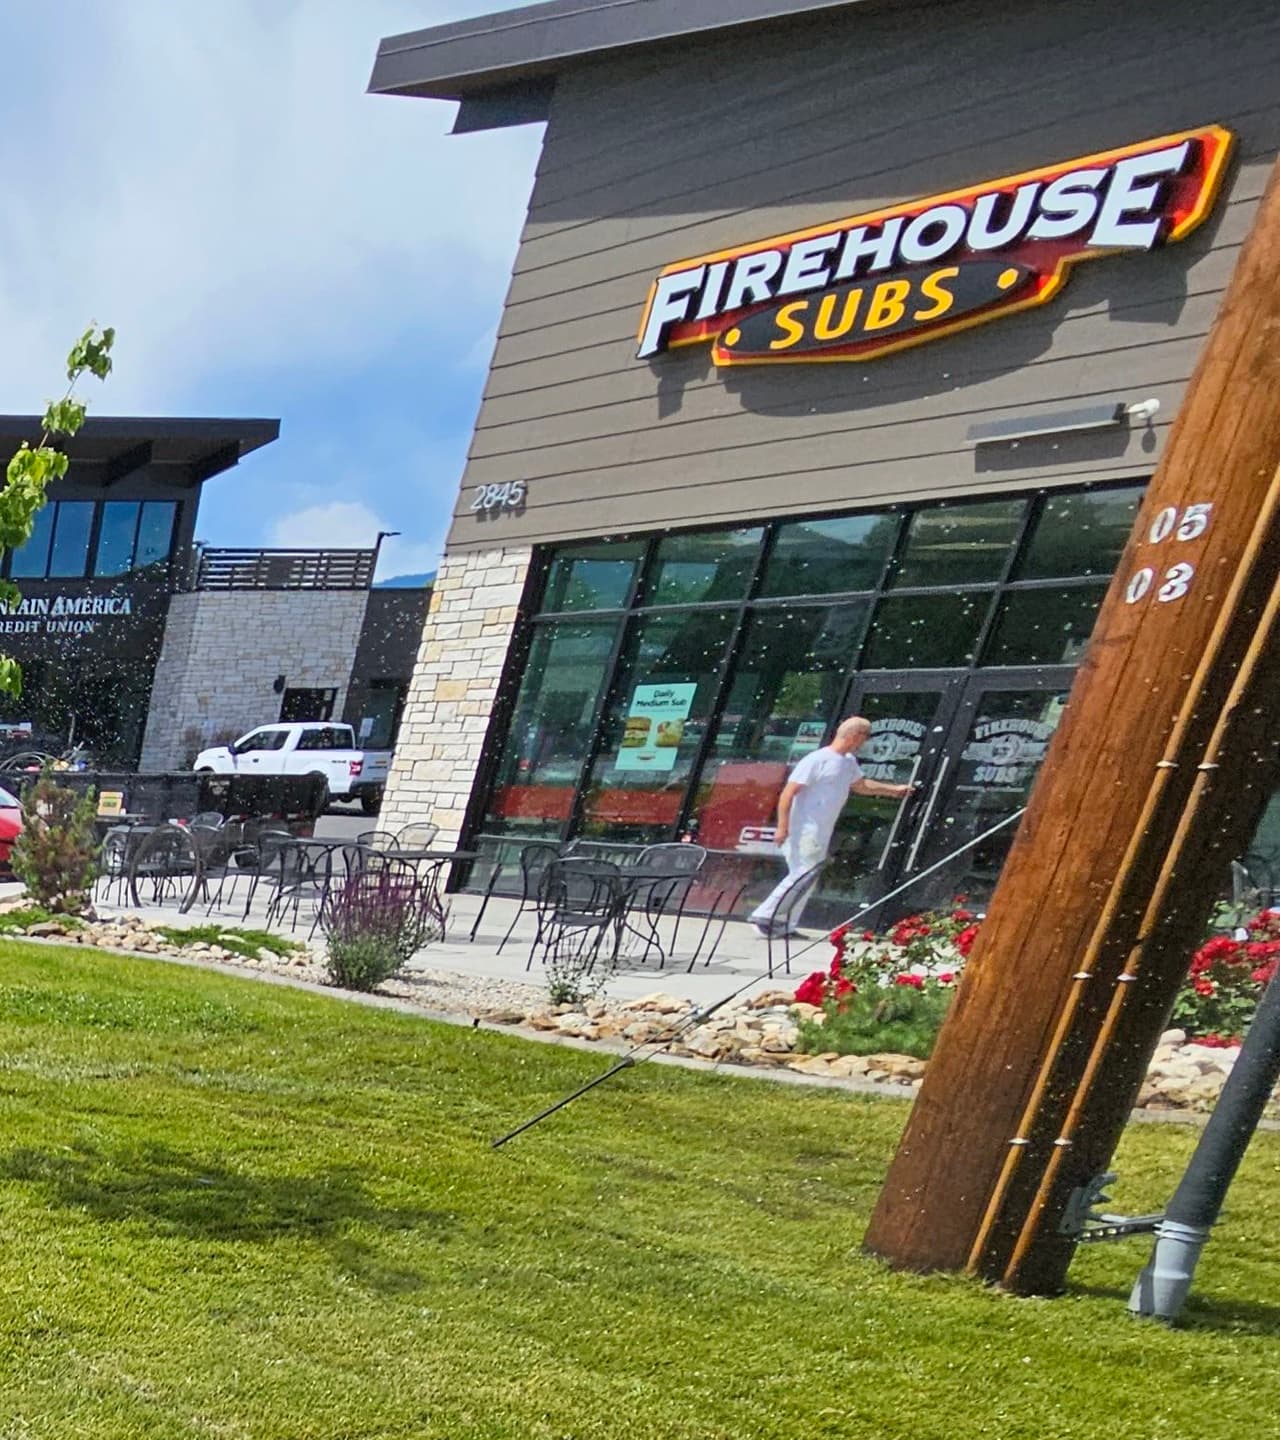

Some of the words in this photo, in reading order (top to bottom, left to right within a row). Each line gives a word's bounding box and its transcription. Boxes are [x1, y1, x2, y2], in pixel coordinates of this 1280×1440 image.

[638, 140, 1191, 358] FIREHOUSE
[770, 266, 959, 350] SUBS
[470, 480, 524, 510] 2845
[1149, 502, 1214, 544] 05
[1125, 562, 1194, 604] 03
[46, 620, 95, 634] UNION
[51, 596, 132, 616] AMERICA
